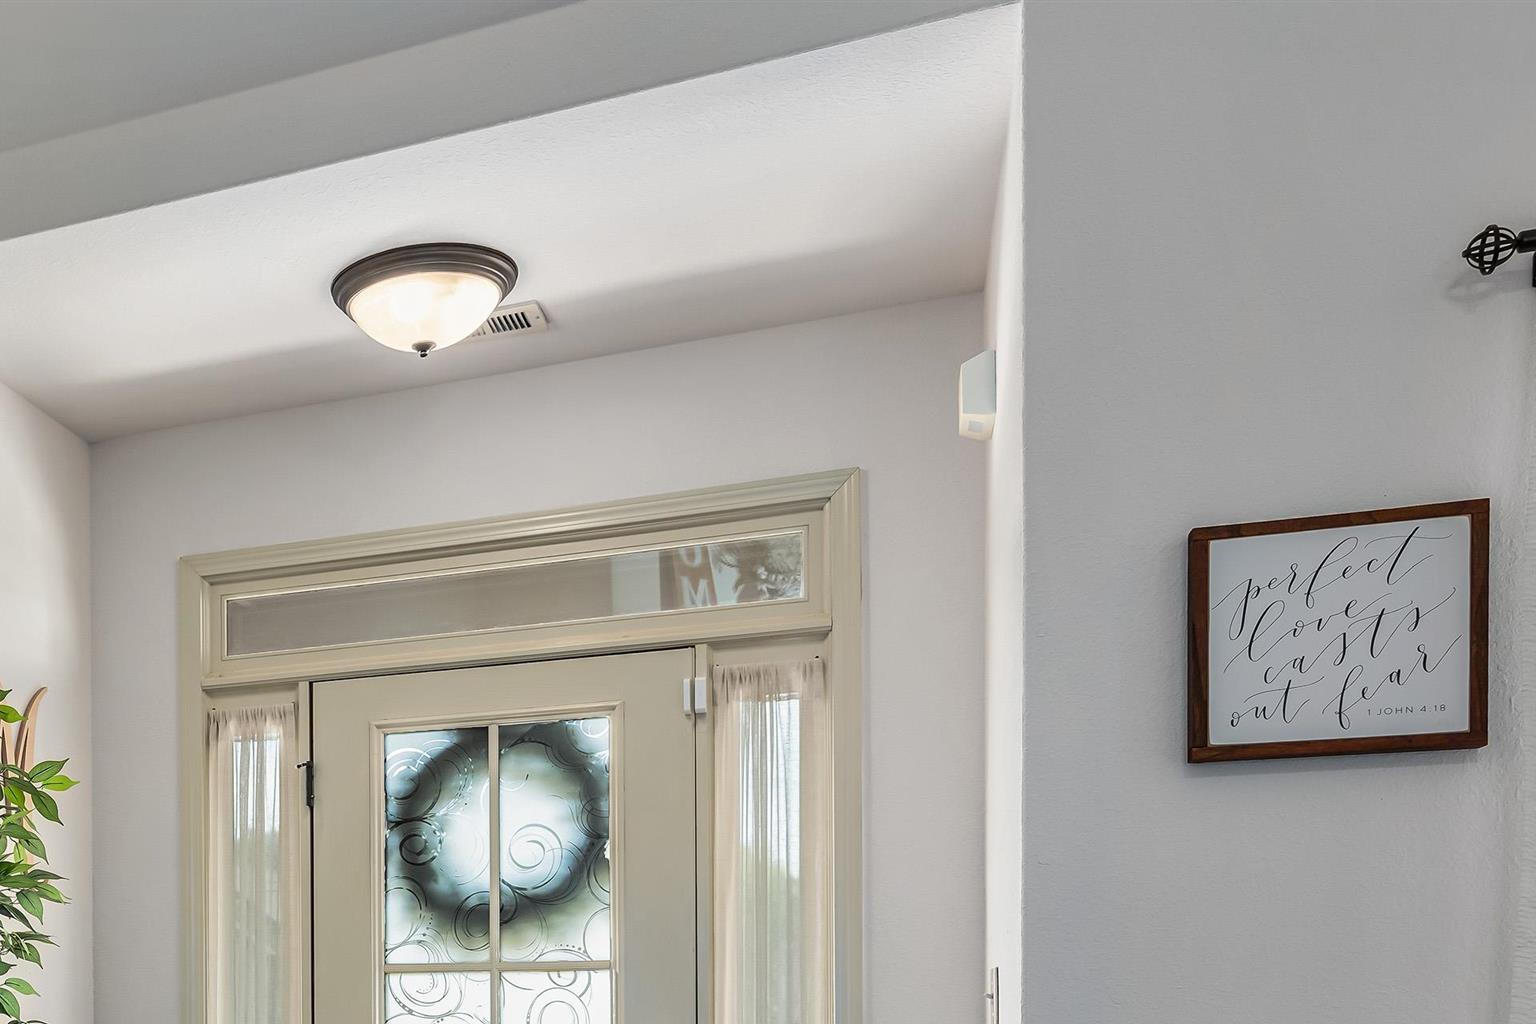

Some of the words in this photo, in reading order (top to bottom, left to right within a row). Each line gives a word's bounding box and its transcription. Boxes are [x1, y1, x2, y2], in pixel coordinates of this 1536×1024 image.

[1212, 526, 1453, 640] perfect
[1224, 593, 1392, 673] love
[1264, 587, 1456, 684] casts
[1230, 676, 1324, 727] out
[1322, 635, 1462, 729] fear
[1376, 706, 1414, 716] JOHN
[1419, 704, 1447, 713] 4:18
